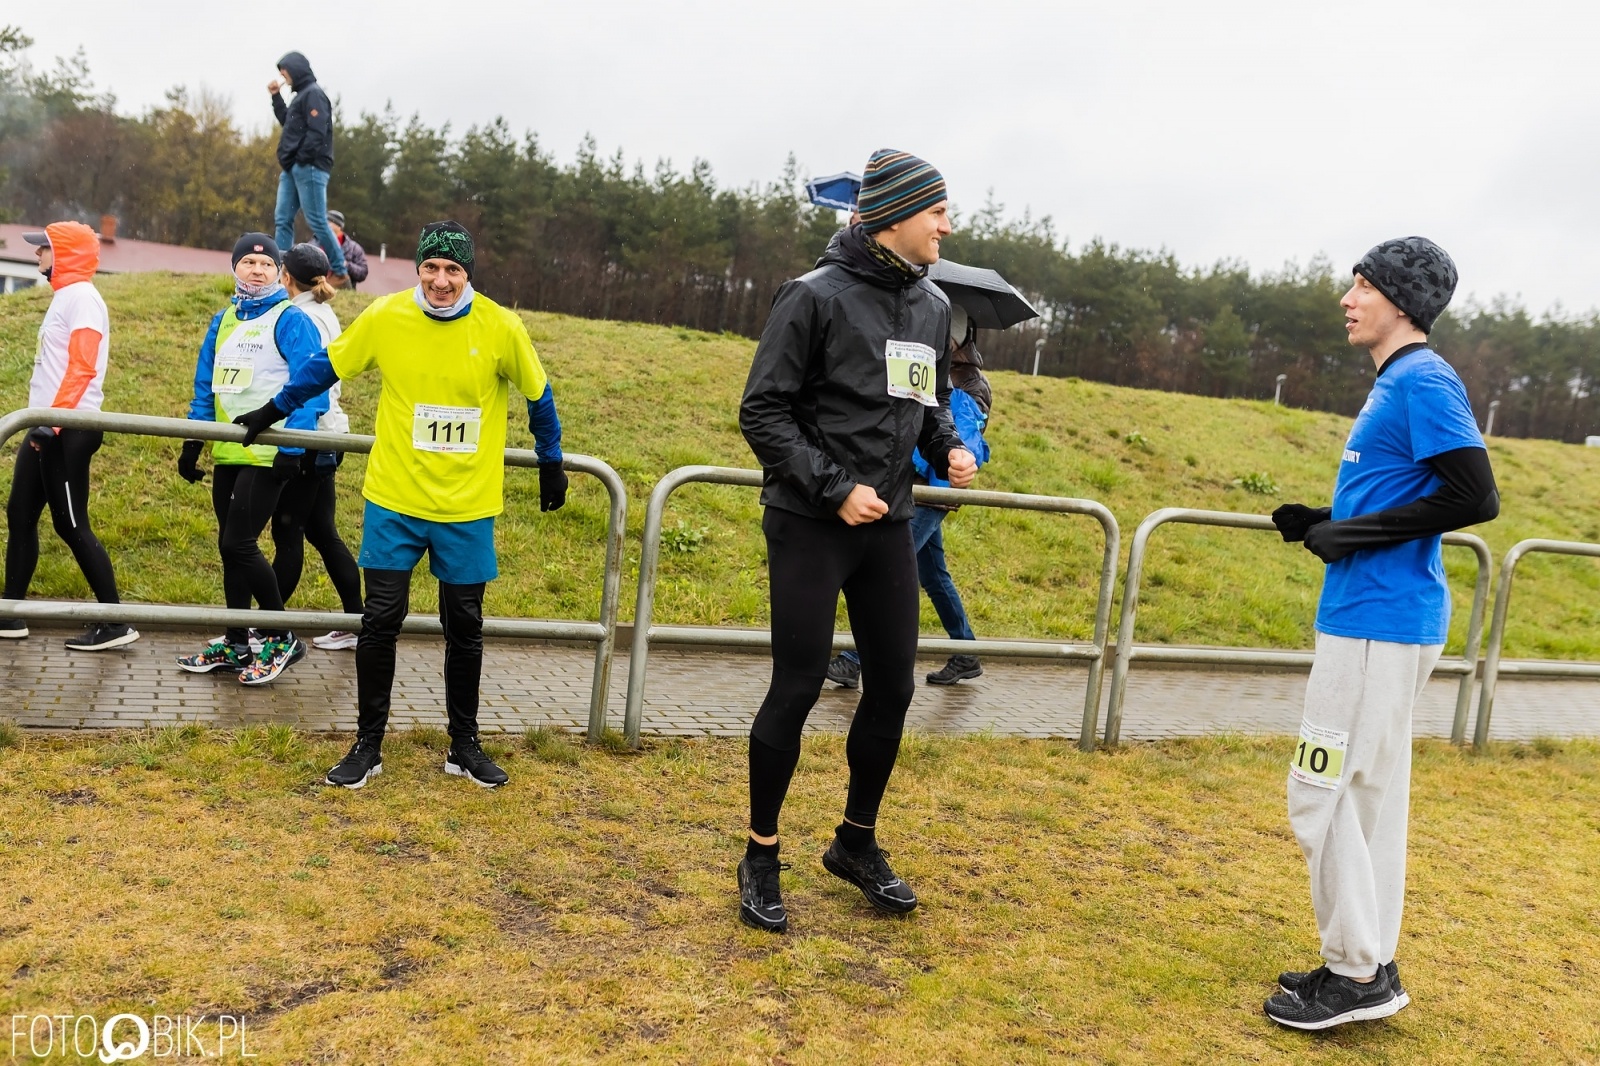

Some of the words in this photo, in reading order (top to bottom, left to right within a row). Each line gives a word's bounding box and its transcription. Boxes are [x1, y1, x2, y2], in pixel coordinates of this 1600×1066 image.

[236, 342, 263, 350] AKTYWNI
[222, 368, 240, 384] 77
[909, 362, 928, 391] 60
[428, 421, 465, 442] 111
[1298, 741, 1329, 773] 10
